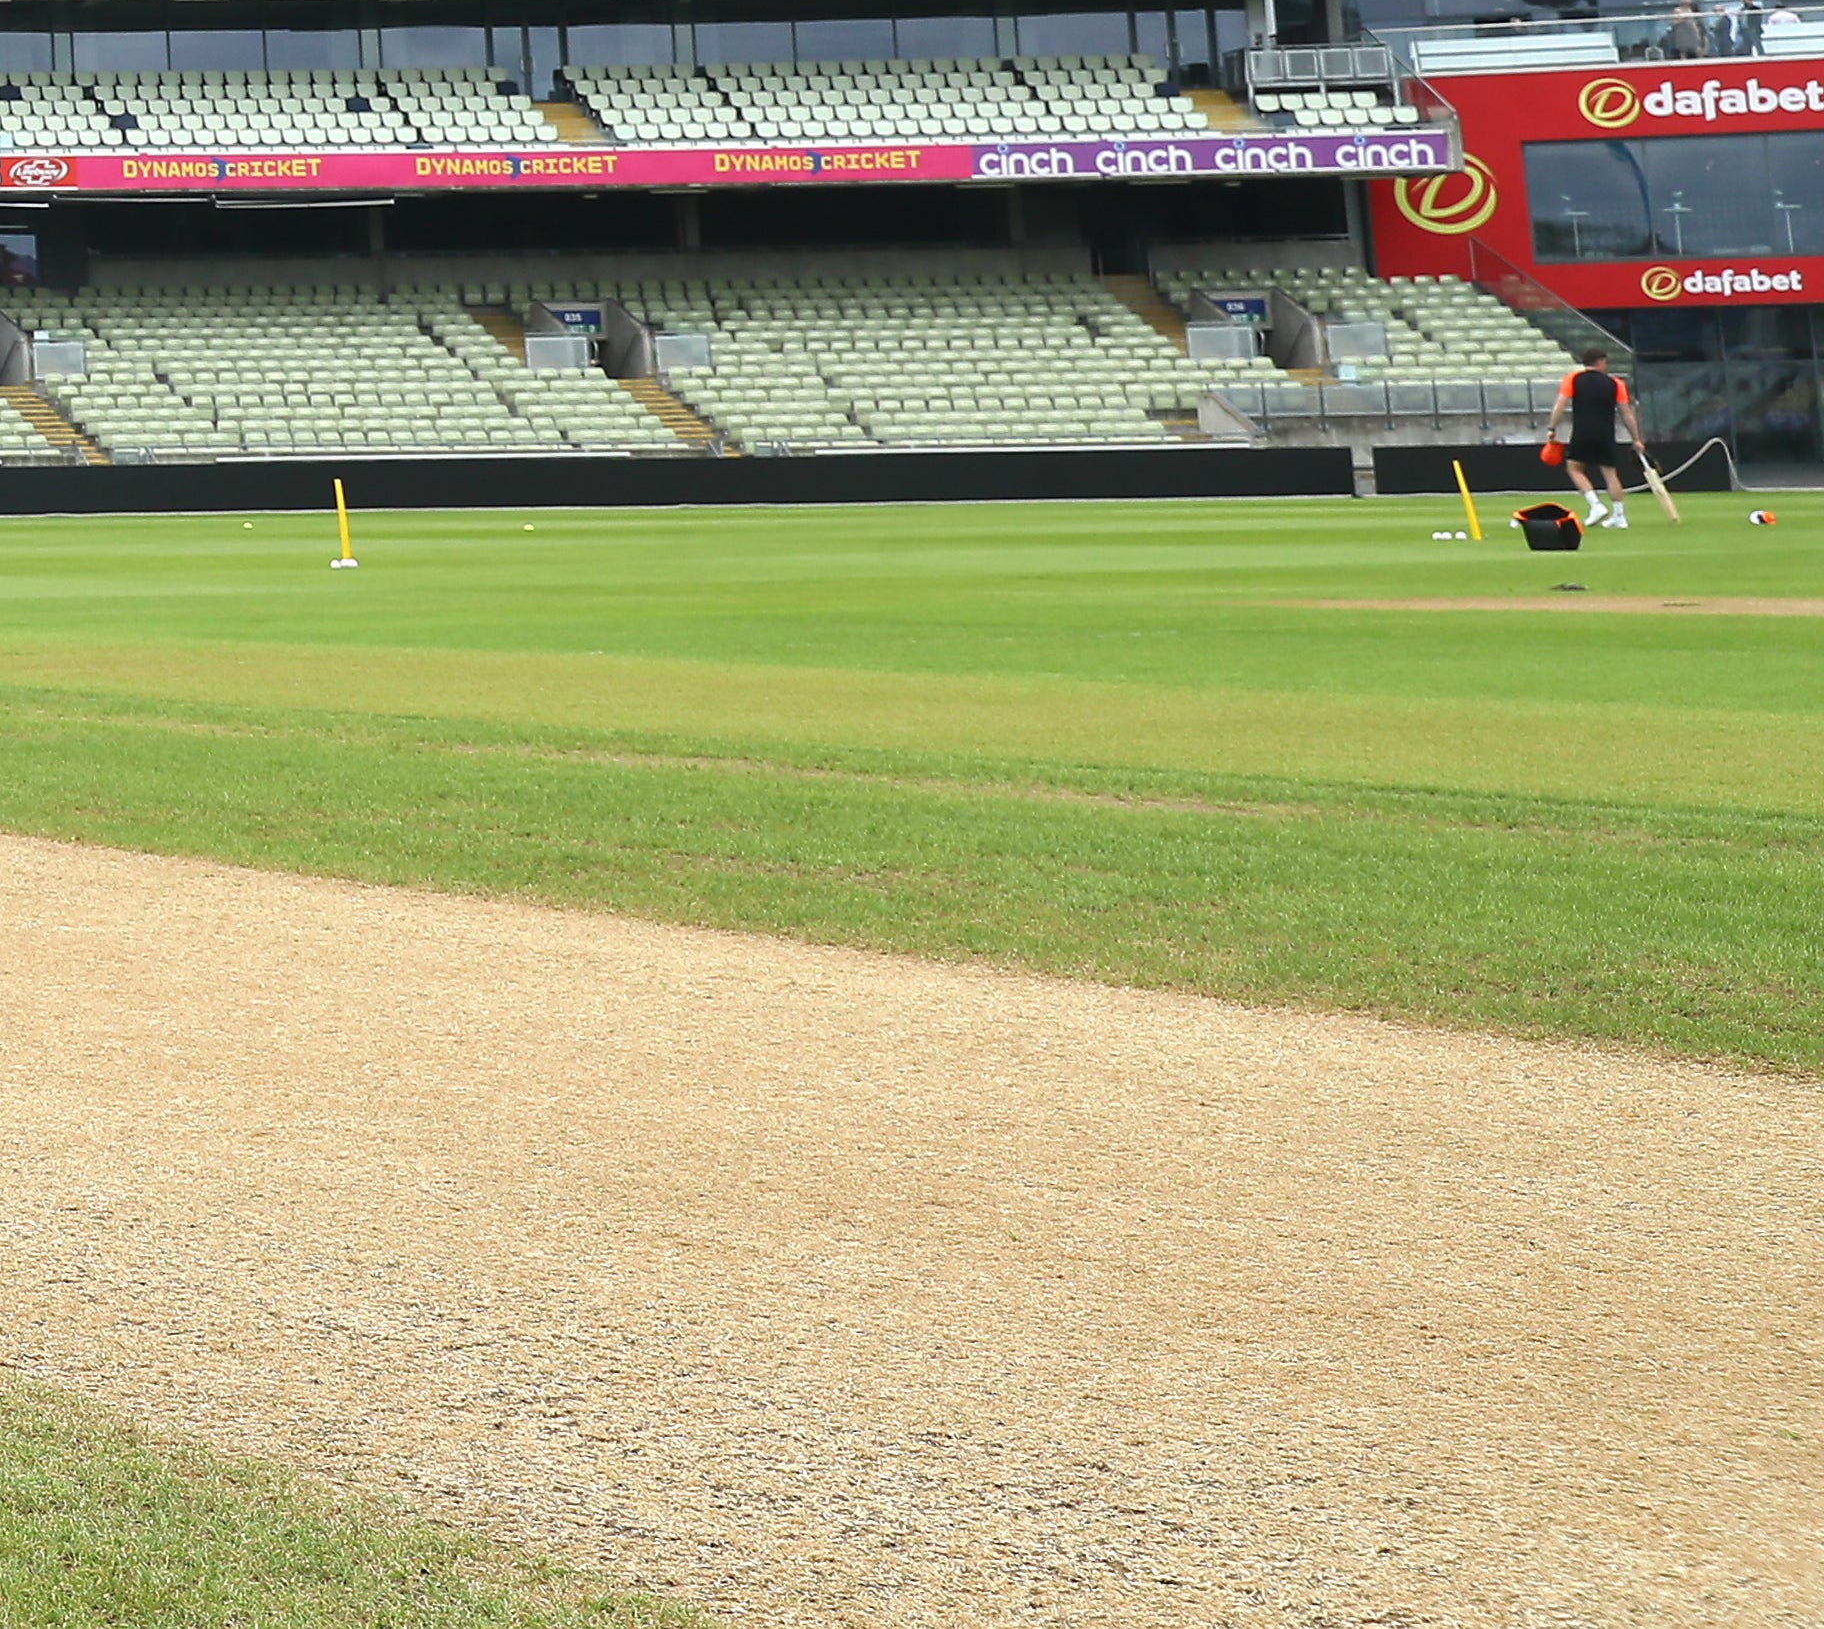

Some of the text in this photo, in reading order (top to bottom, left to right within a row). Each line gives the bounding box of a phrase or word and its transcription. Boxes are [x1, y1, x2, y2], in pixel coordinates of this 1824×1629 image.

[1643, 78, 1824, 121] dafabet
[415, 155, 617, 175] DYNAMOS CRICKET
[714, 151, 921, 171] DYNAMOS CRICKET
[979, 144, 1074, 175] cinch
[1095, 141, 1192, 174] cinch
[1214, 138, 1313, 169] cinch
[1335, 135, 1434, 167] cinch
[123, 158, 321, 178] DYNAMOS CRICKET
[1683, 268, 1803, 297] dafabet
